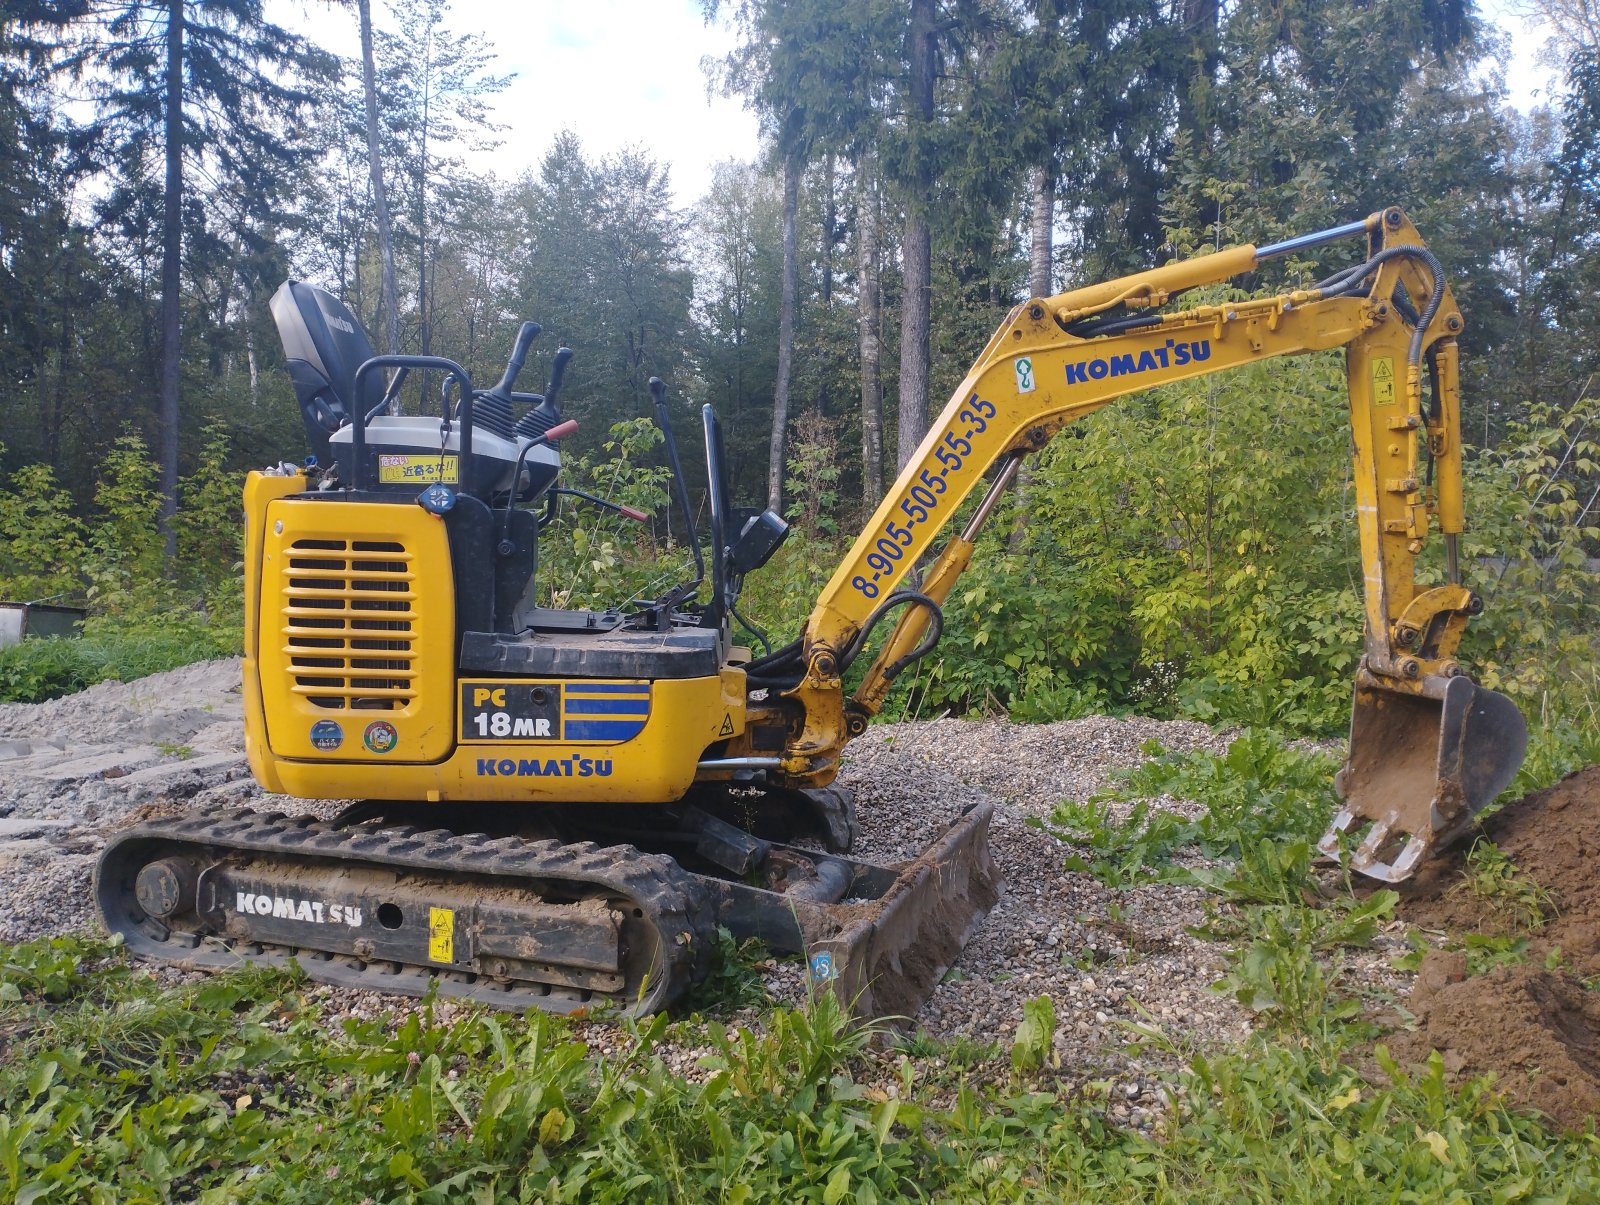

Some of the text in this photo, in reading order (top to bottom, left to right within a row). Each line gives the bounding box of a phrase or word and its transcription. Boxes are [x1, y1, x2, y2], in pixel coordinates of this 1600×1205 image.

[1065, 339, 1212, 385] KOMATSU
[852, 393, 997, 599] 8-905-505-55-35
[473, 688, 506, 707] PC
[474, 712, 551, 737] 18MR
[476, 754, 613, 777] KOMATSU
[236, 892, 363, 928] KOMATSU
